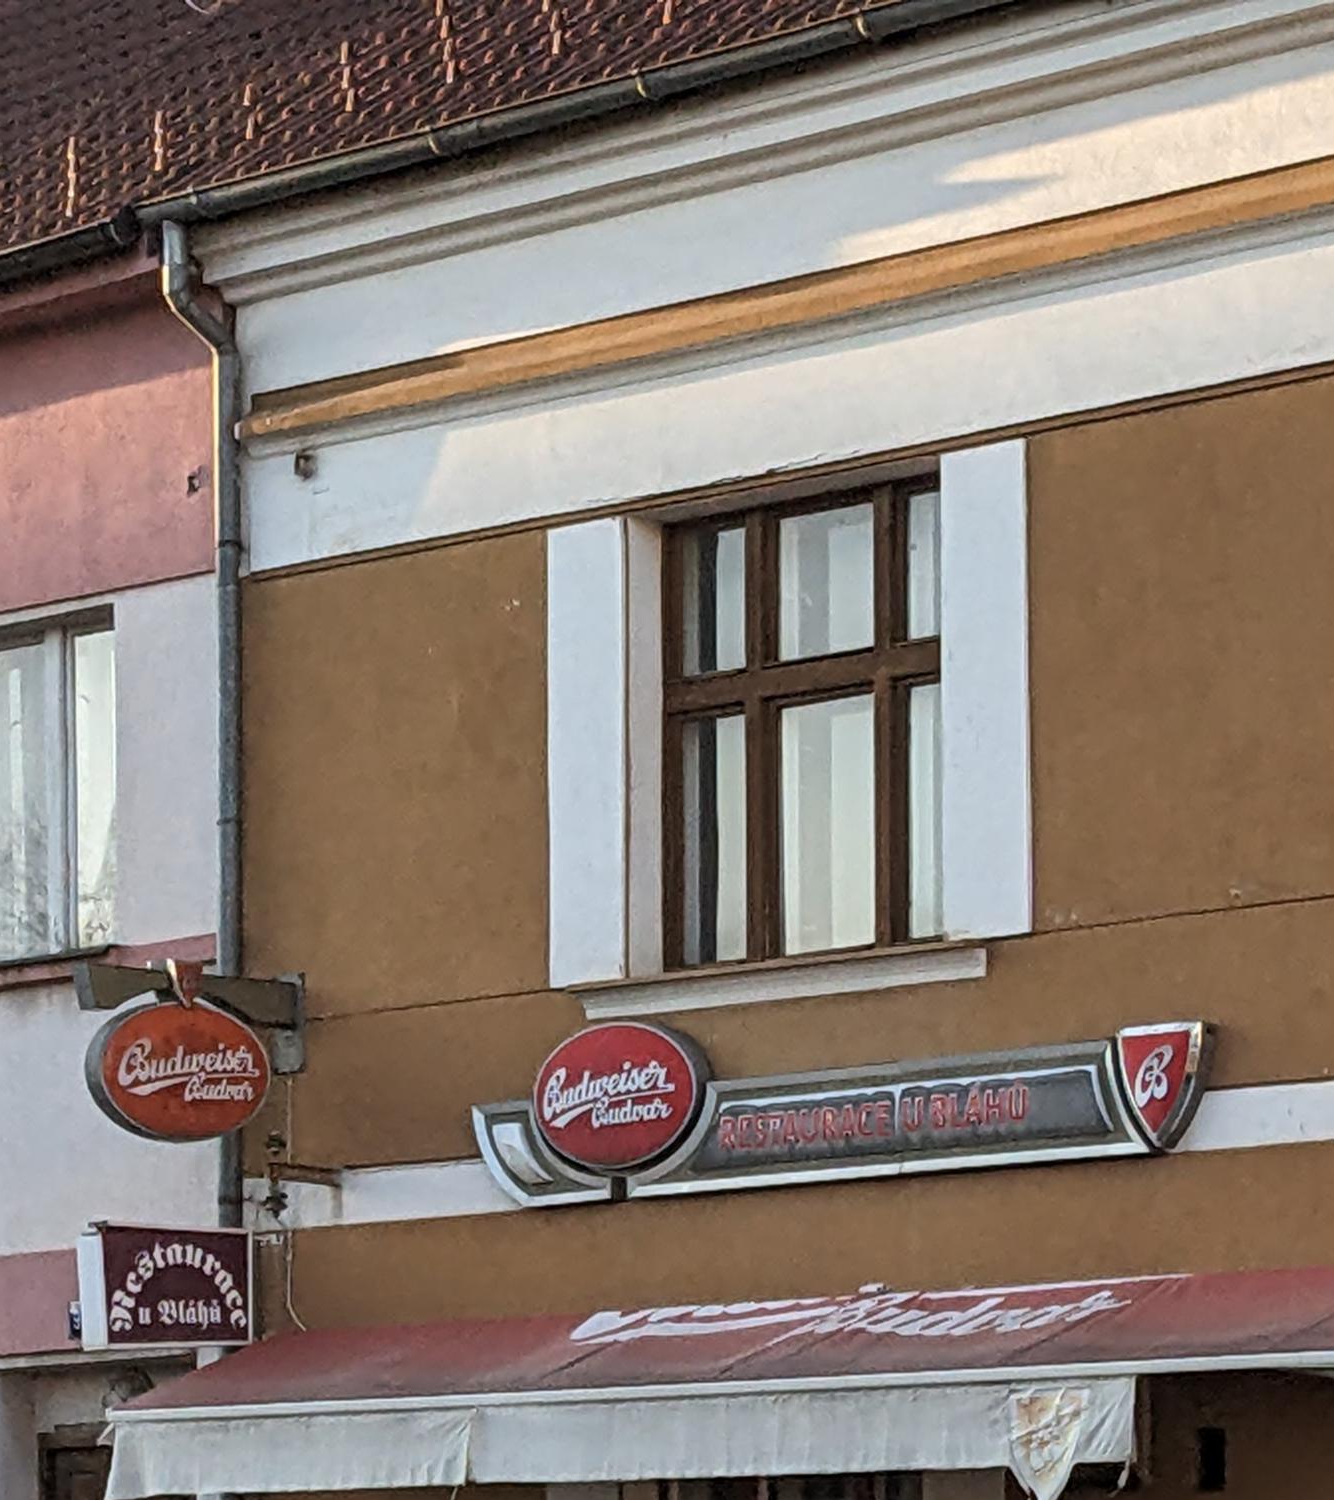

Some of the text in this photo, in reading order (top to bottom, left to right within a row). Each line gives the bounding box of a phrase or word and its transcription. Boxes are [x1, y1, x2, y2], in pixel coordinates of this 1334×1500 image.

[118, 1037, 260, 1091] Budweiser
[184, 1072, 255, 1102] Budvar
[543, 1060, 676, 1122] Budweiser
[591, 1094, 673, 1129] Budvar
[718, 1100, 893, 1151] RESTAURACE
[901, 1096, 924, 1132] U
